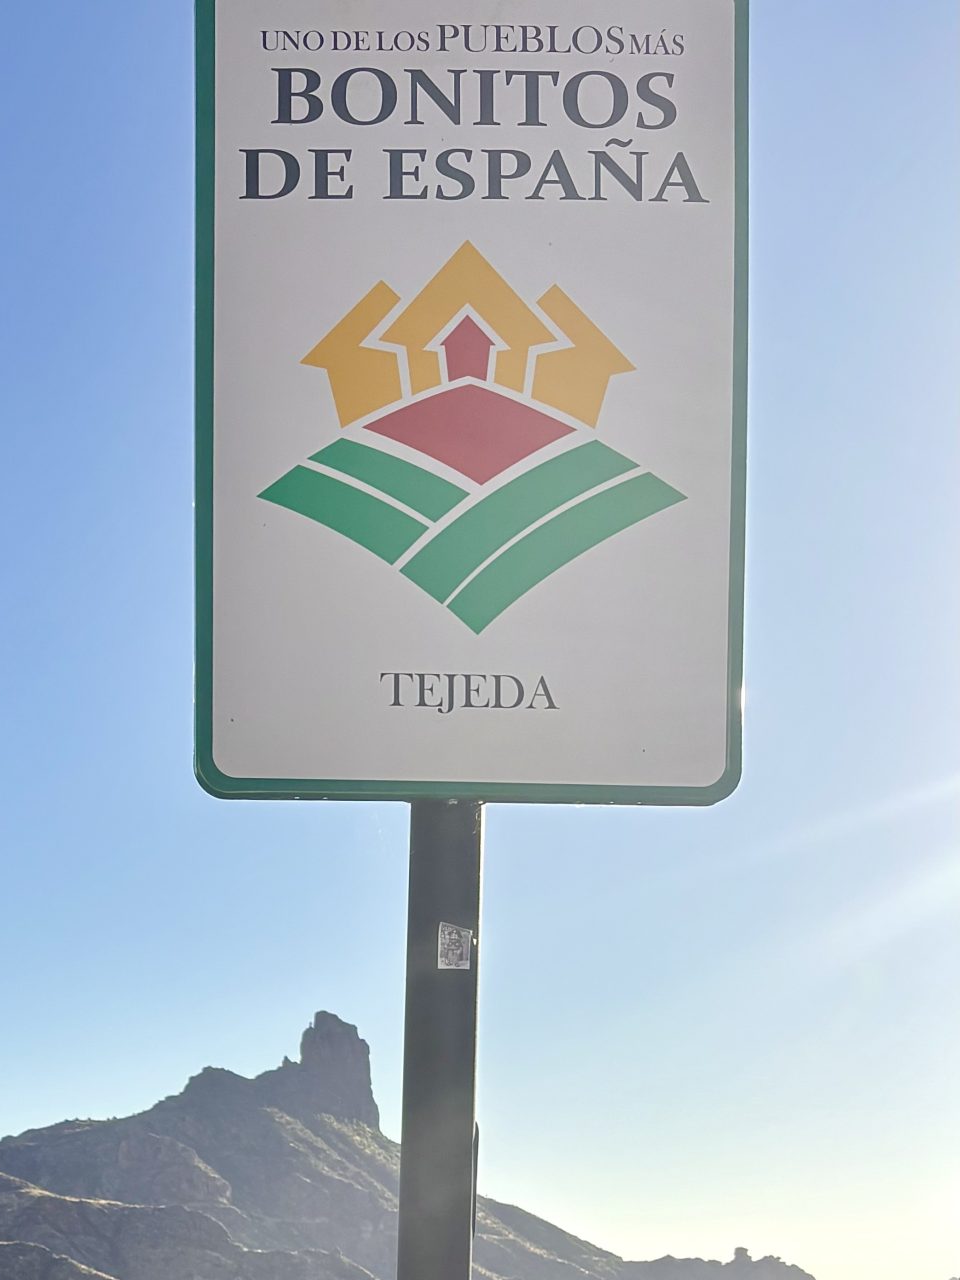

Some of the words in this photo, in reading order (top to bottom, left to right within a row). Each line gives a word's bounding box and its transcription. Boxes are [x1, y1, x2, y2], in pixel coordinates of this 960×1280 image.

[260, 30, 324, 52] UNO
[330, 30, 371, 51] DE
[376, 30, 430, 52] LOS
[436, 24, 625, 55] PUEBLOS
[629, 28, 685, 56] MÁS
[270, 67, 678, 130] BONITOS
[238, 148, 354, 200] DE
[382, 138, 710, 203] ESPAÑA
[380, 672, 560, 714] TEJEDA
